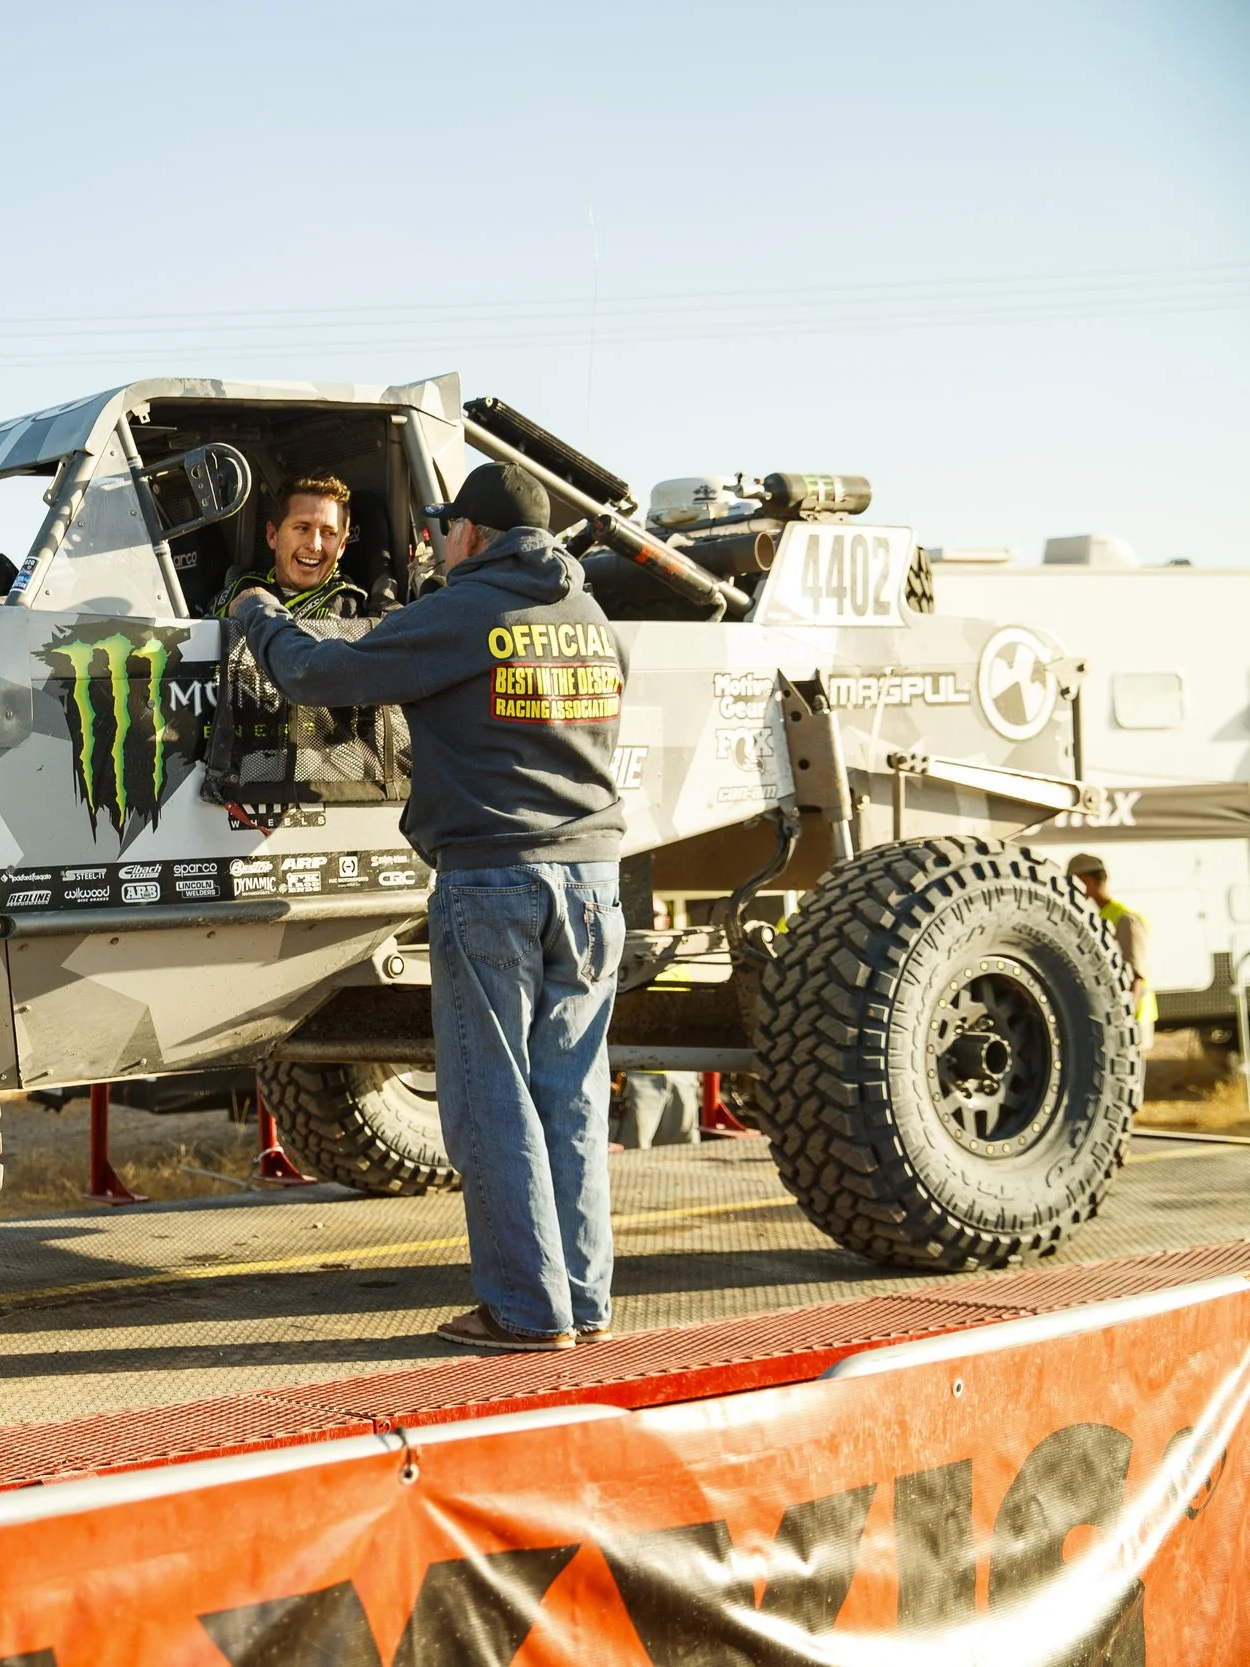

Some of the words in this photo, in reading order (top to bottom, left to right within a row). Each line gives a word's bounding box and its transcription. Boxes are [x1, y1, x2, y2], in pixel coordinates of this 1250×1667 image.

[801, 534, 891, 617] 4402
[488, 624, 616, 659] OFFICIAL
[495, 667, 534, 694] BEST
[536, 667, 551, 695] IN
[551, 667, 576, 695] THE
[577, 667, 621, 694] DESERT
[714, 672, 774, 697] Motive
[830, 674, 970, 706] MAGPUL
[495, 698, 550, 718] RACING
[551, 698, 619, 719] ASSOCIATION
[720, 696, 767, 719] Gear
[716, 727, 774, 760] FOX
[174, 863, 217, 875] sparco
[281, 857, 327, 870] ARP
[7, 891, 50, 902] REDLINE
[64, 886, 110, 899] wilwood
[178, 881, 212, 889] LINCOLN
[233, 877, 277, 896] DYNAMIC
[185, 889, 216, 897] WELDERS
